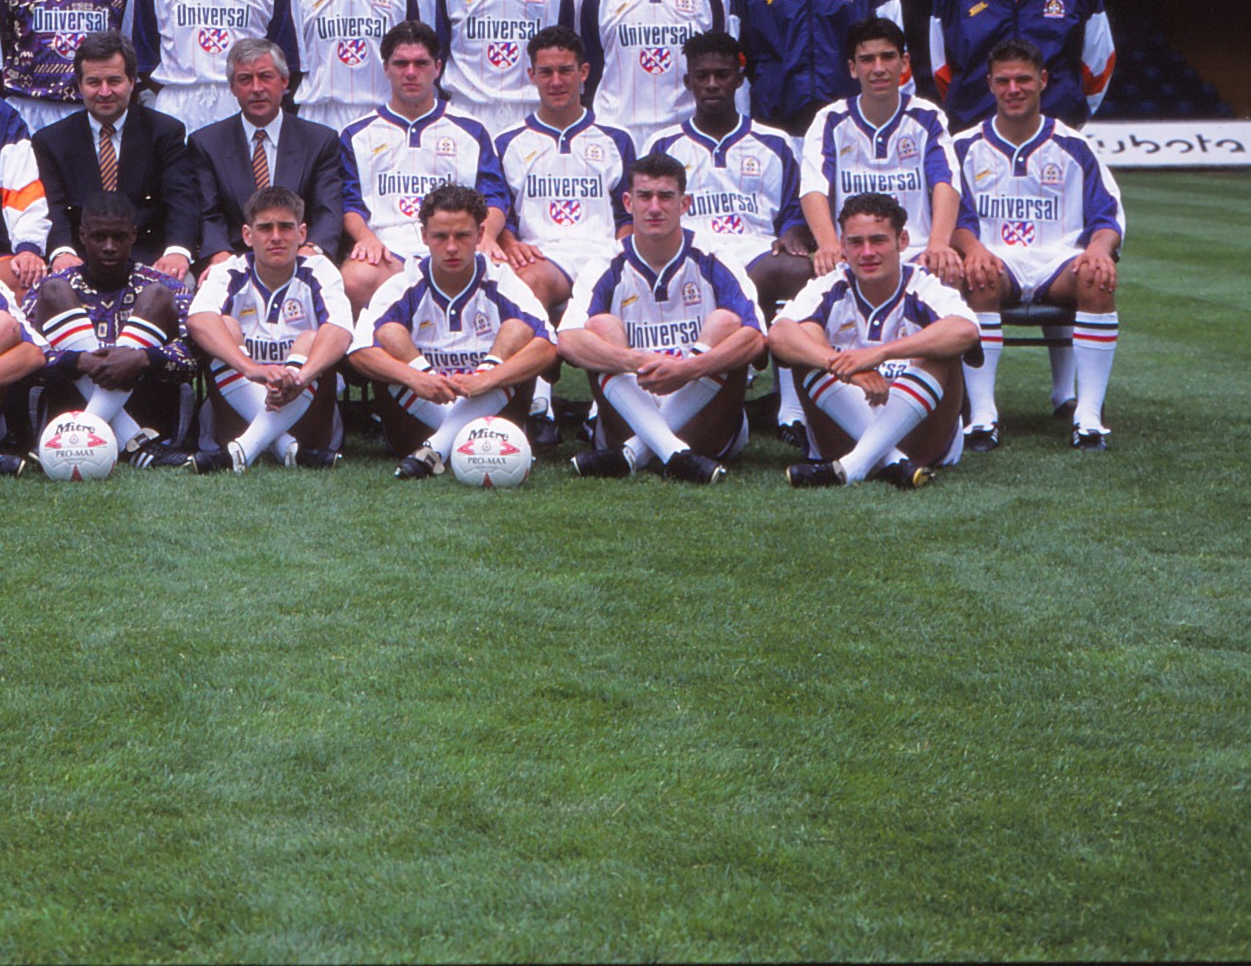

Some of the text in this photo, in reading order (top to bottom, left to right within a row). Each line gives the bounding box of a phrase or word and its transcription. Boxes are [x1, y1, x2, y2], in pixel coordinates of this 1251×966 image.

[34, 6, 109, 33] Universal
[177, 3, 249, 29] Universal
[317, 15, 387, 39] Universal
[467, 16, 541, 40] Universal
[1086, 134, 1245, 154] ubota
[527, 173, 603, 199] Universal
[841, 167, 922, 194] Universal
[685, 191, 759, 217] Universal
[979, 194, 1059, 221] Universal
[626, 315, 701, 349] Universal
[54, 421, 96, 435] Mitre
[467, 427, 509, 441] Mitre
[467, 456, 507, 465] PRO-MAX
